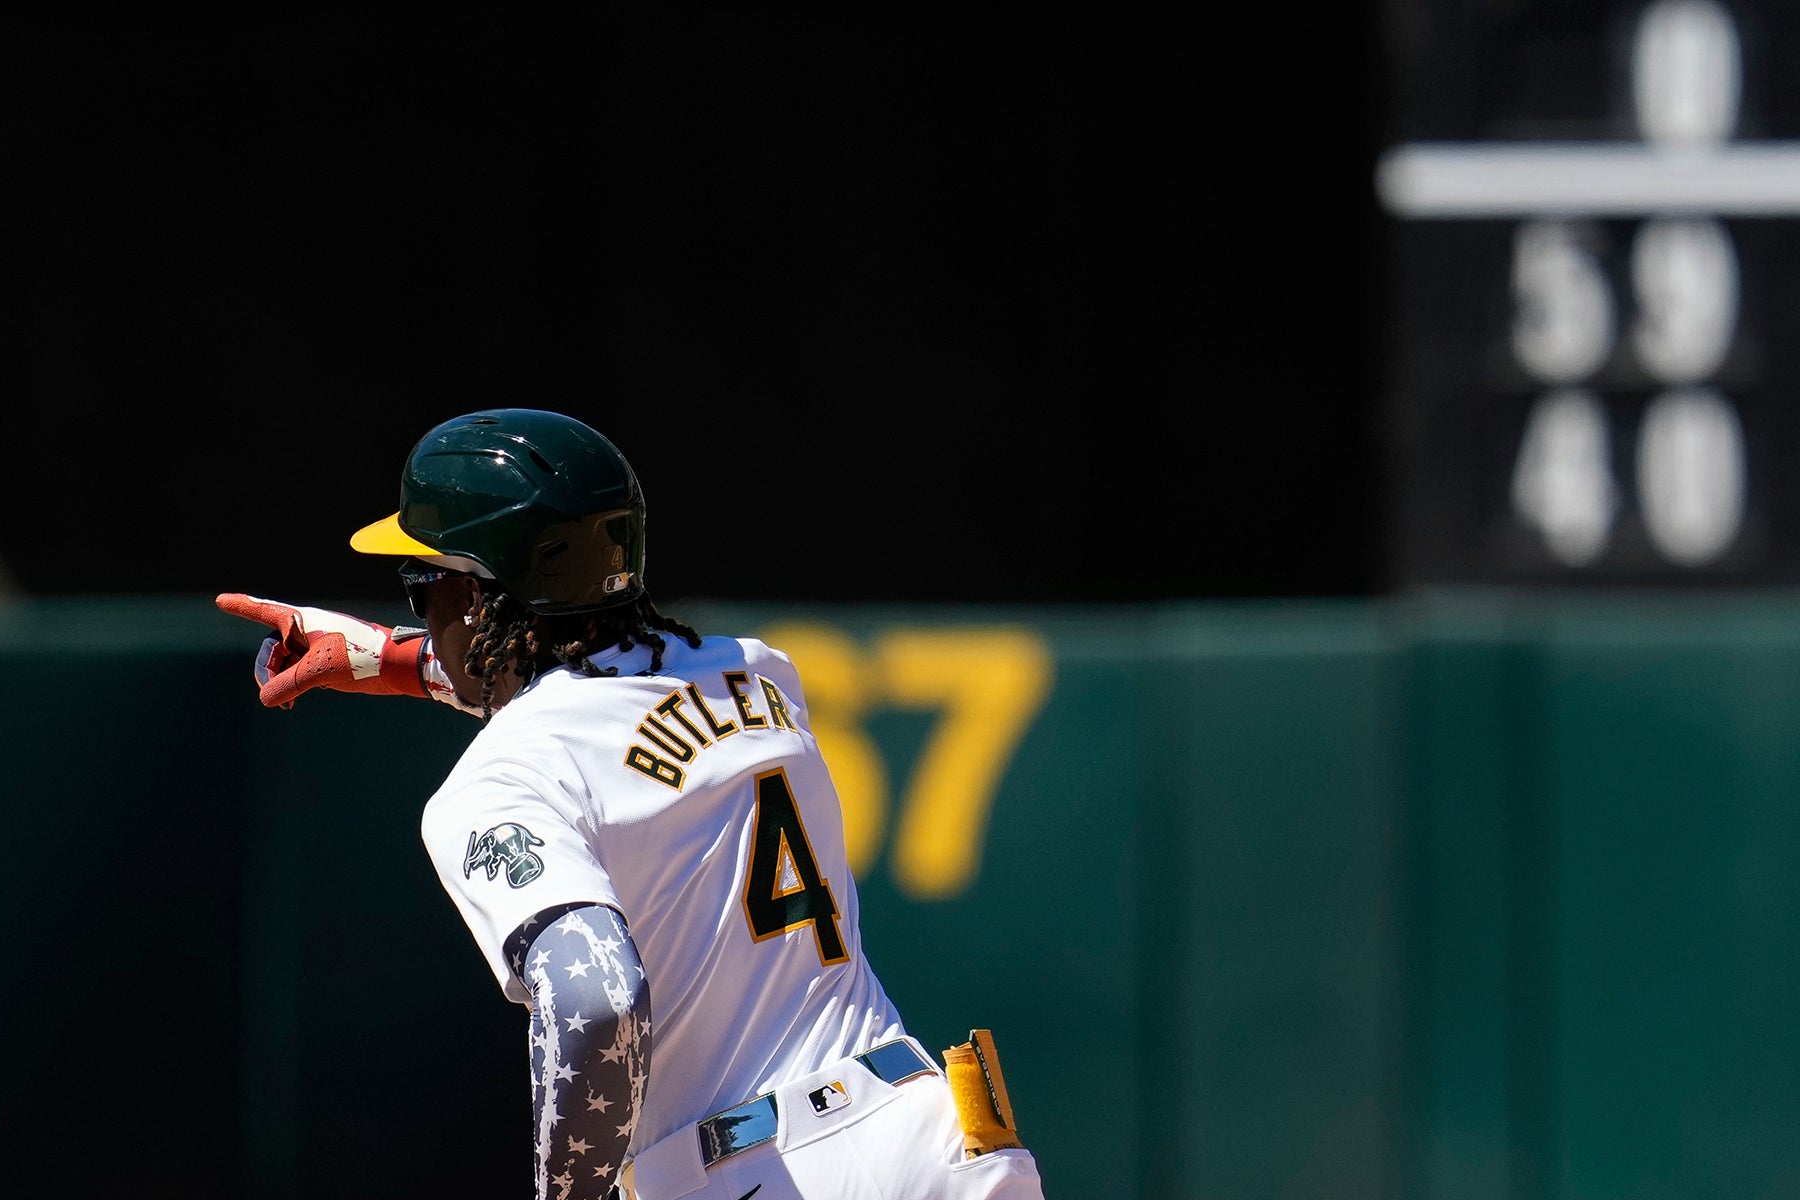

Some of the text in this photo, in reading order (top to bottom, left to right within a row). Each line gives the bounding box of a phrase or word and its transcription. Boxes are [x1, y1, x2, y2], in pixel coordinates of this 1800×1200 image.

[611, 545, 623, 569] 4
[624, 671, 798, 792] BUTLER
[742, 765, 850, 967] 4
[975, 1045, 1001, 1116] EVOSHIELD
